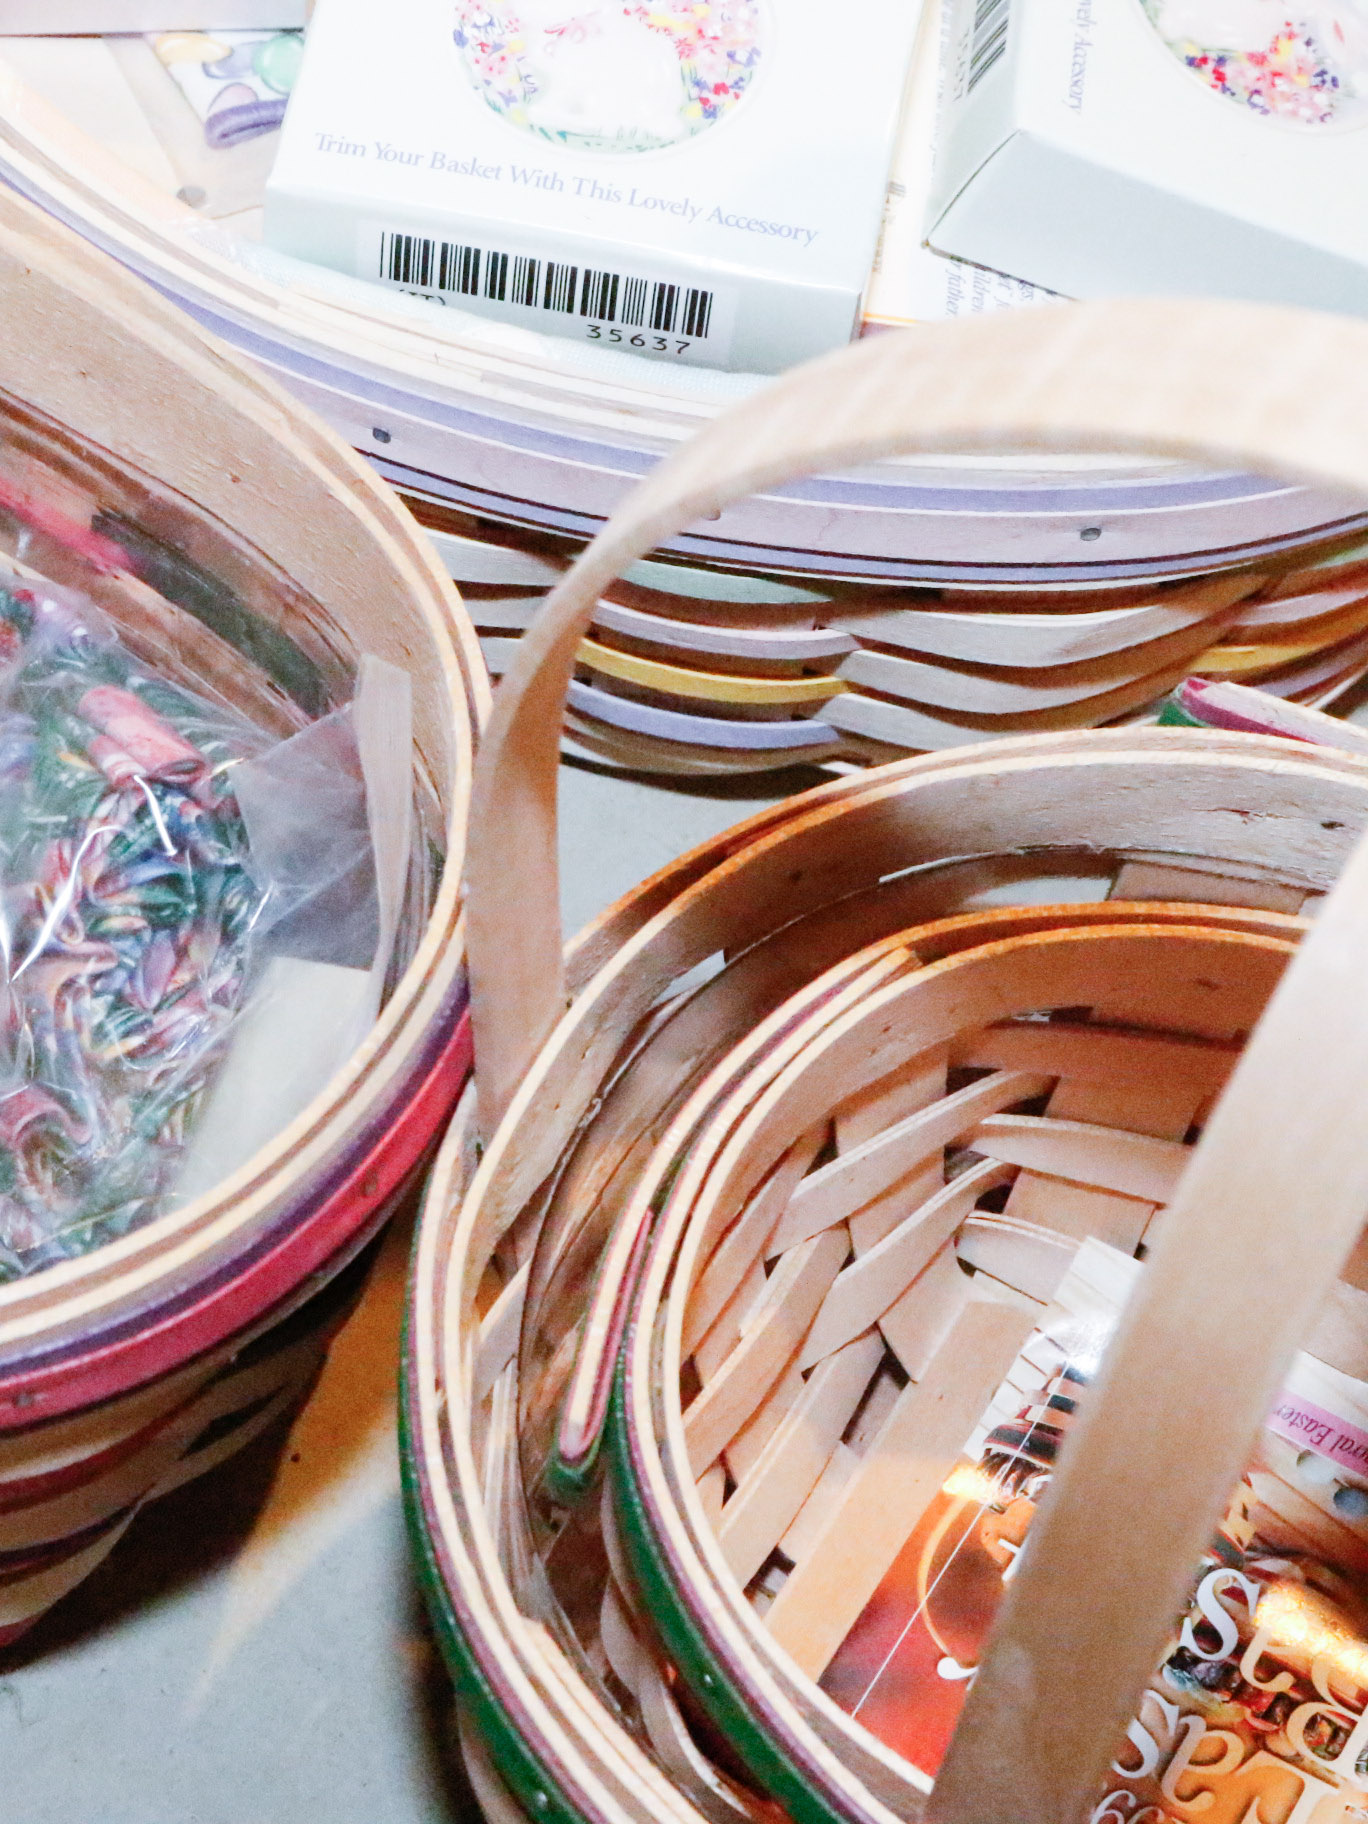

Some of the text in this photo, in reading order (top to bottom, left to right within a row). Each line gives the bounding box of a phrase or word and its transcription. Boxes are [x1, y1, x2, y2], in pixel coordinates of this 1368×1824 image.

[315, 131, 819, 248] Trim Your Basket With This Lovely Accessory
[586, 323, 690, 355] 35637
